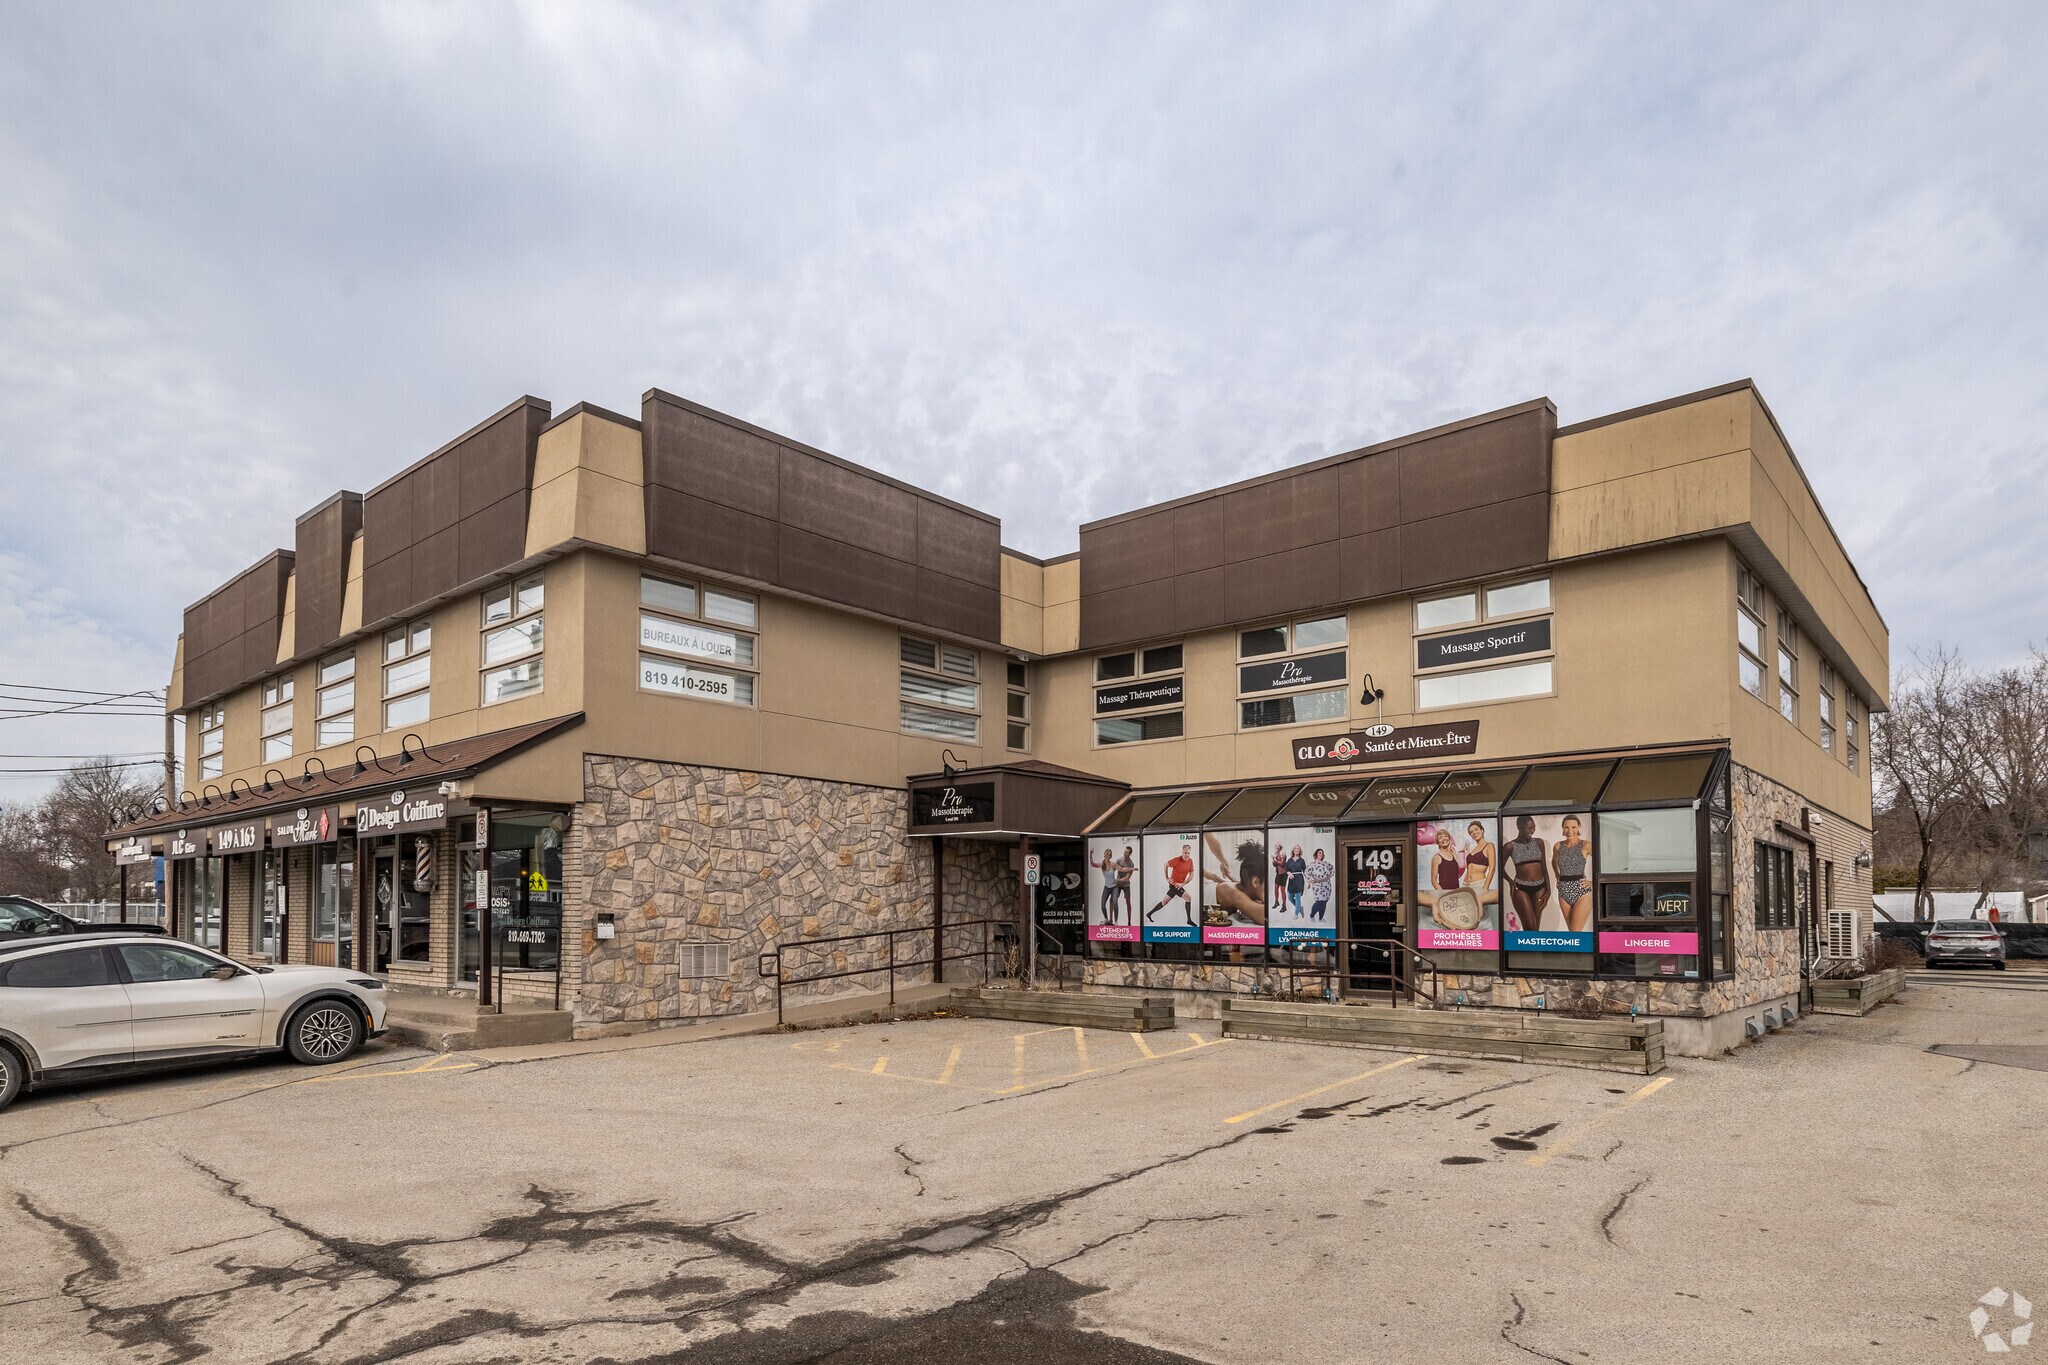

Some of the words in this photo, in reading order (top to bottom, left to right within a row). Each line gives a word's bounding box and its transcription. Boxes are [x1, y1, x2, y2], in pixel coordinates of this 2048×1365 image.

[643, 628, 690, 648] BUREAUX
[691, 635, 699, 650] À
[701, 640, 732, 656] LOUER
[1441, 641, 1485, 655] Massage
[1487, 631, 1526, 649] Sportif
[1280, 661, 1303, 679] Pro
[645, 670, 668, 685] 819
[671, 675, 728, 695] 410-2595
[1272, 674, 1313, 687] Massothérapie
[1099, 694, 1129, 705] Massage
[1128, 686, 1181, 700] Thérapeutique
[1371, 725, 1387, 736] 149
[1298, 745, 1326, 760] CLO
[1365, 740, 1395, 753] Santé
[1395, 740, 1407, 750] et
[1407, 731, 1471, 749] Mieux-Être
[941, 787, 963, 807] Pro
[368, 805, 401, 830] Design
[402, 799, 445, 823] Coiffure
[931, 805, 974, 817] Massothérapie
[218, 829, 233, 850] 149
[233, 828, 240, 848] À
[240, 826, 256, 848] 163
[1353, 850, 1394, 870] 149
[1096, 932, 1134, 940] COMPRESSIFS
[1099, 926, 1130, 934] VÊTEMENTS
[1207, 930, 1260, 940] MASSOTHÉRAPIE
[1284, 930, 1319, 938] DRAINAGE
[1433, 939, 1483, 947] MAMMAIRES
[1517, 937, 1581, 946] MASTECTOMIE
[1624, 939, 1670, 948] LINGERIE
